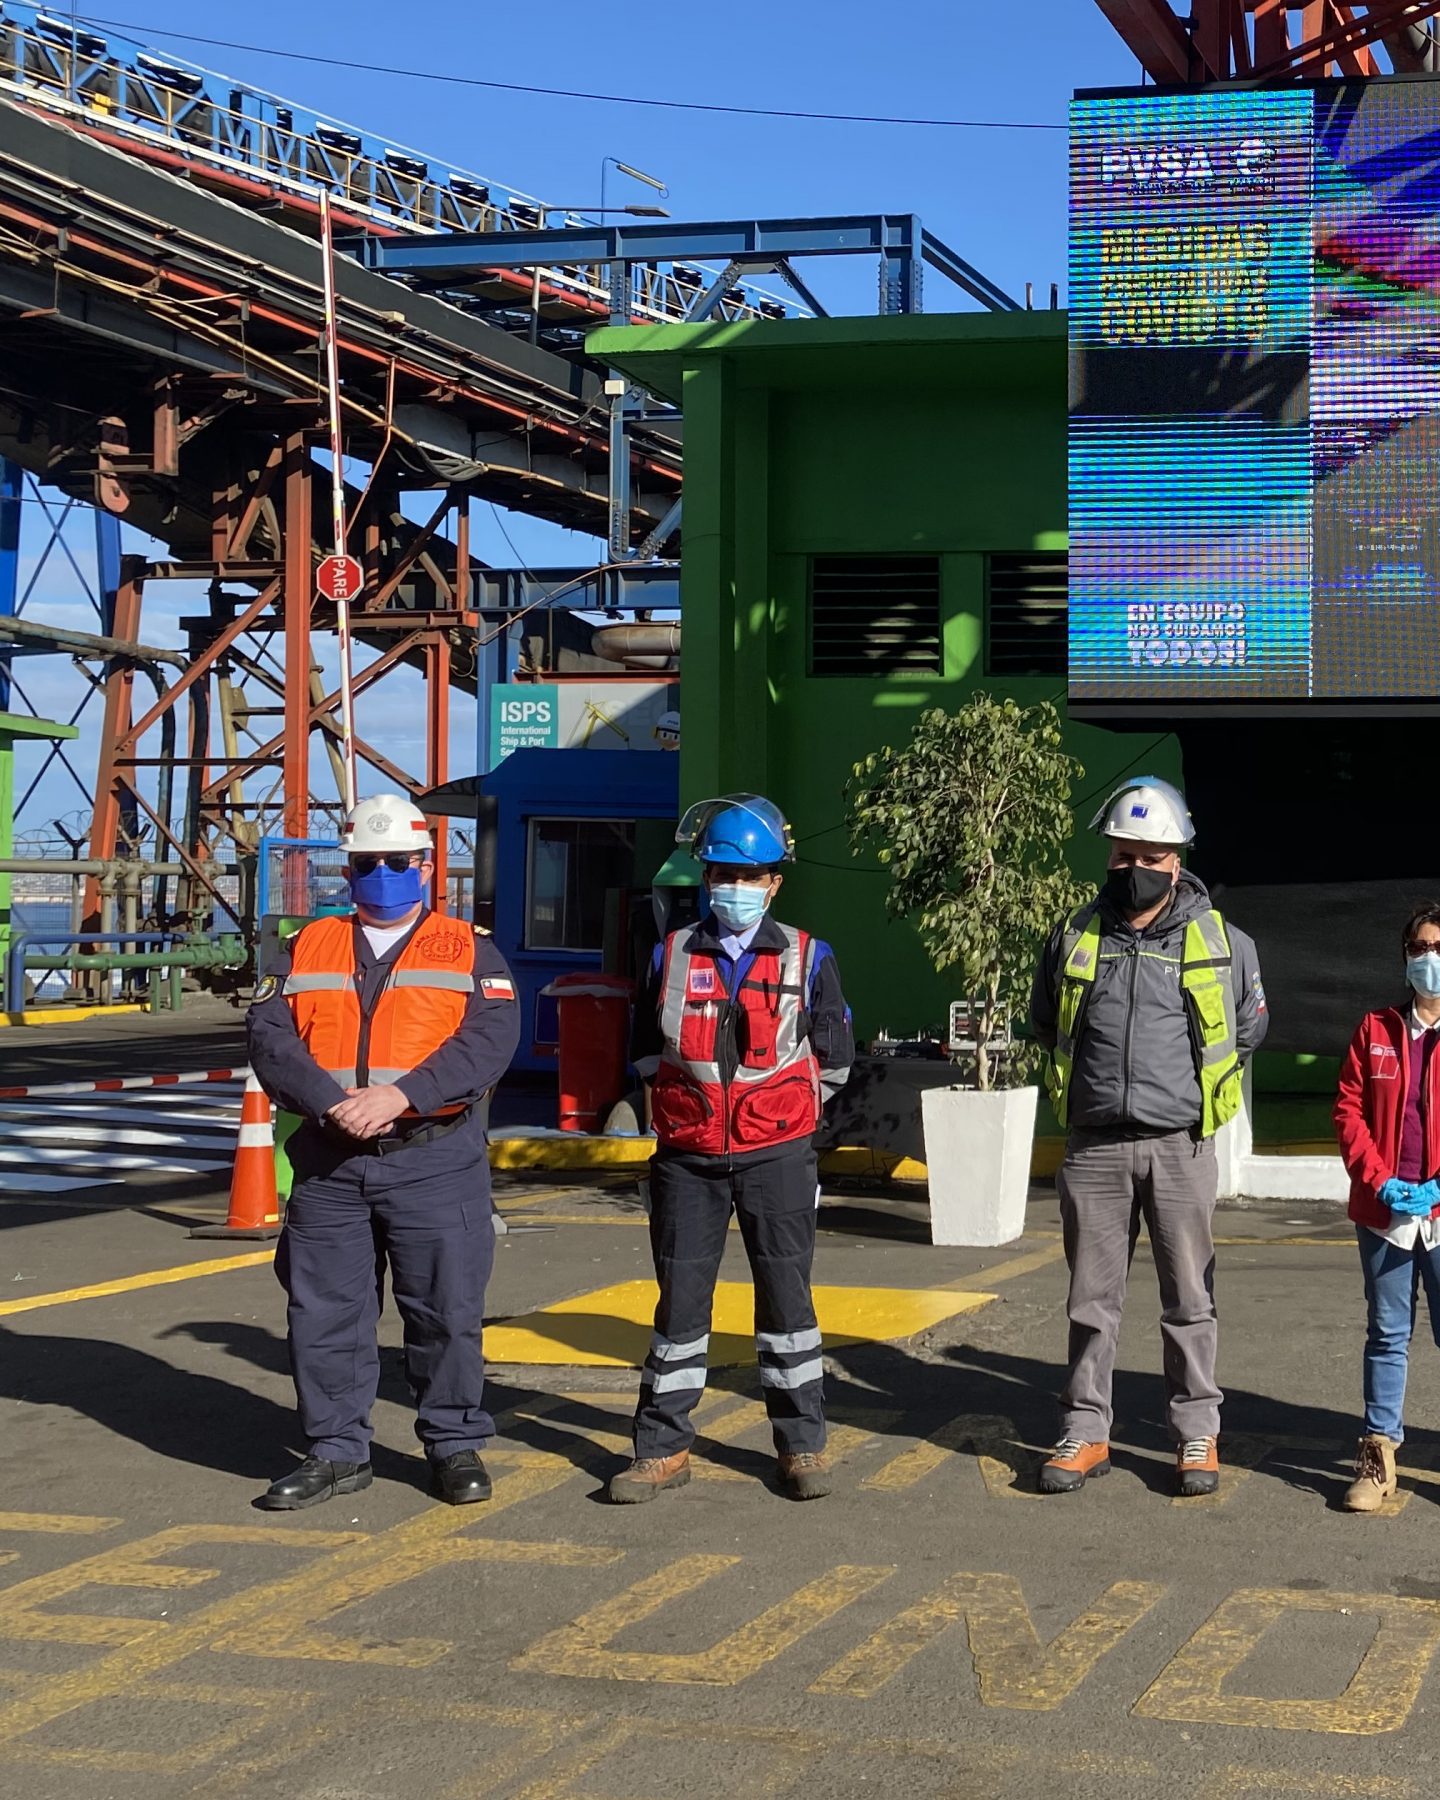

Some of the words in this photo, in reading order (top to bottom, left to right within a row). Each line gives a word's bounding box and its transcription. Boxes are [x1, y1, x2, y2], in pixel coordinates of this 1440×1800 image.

[1102, 148, 1215, 186] PVSA
[332, 558, 348, 597] PARE
[1127, 604, 1155, 622] EN
[1162, 602, 1246, 622] EQUIPO
[1127, 623, 1160, 639] NOS
[501, 701, 551, 723] ISPS
[501, 725, 551, 735] International
[500, 736, 519, 748] Ship
[520, 736, 527, 746] &
[528, 736, 545, 746] Port
